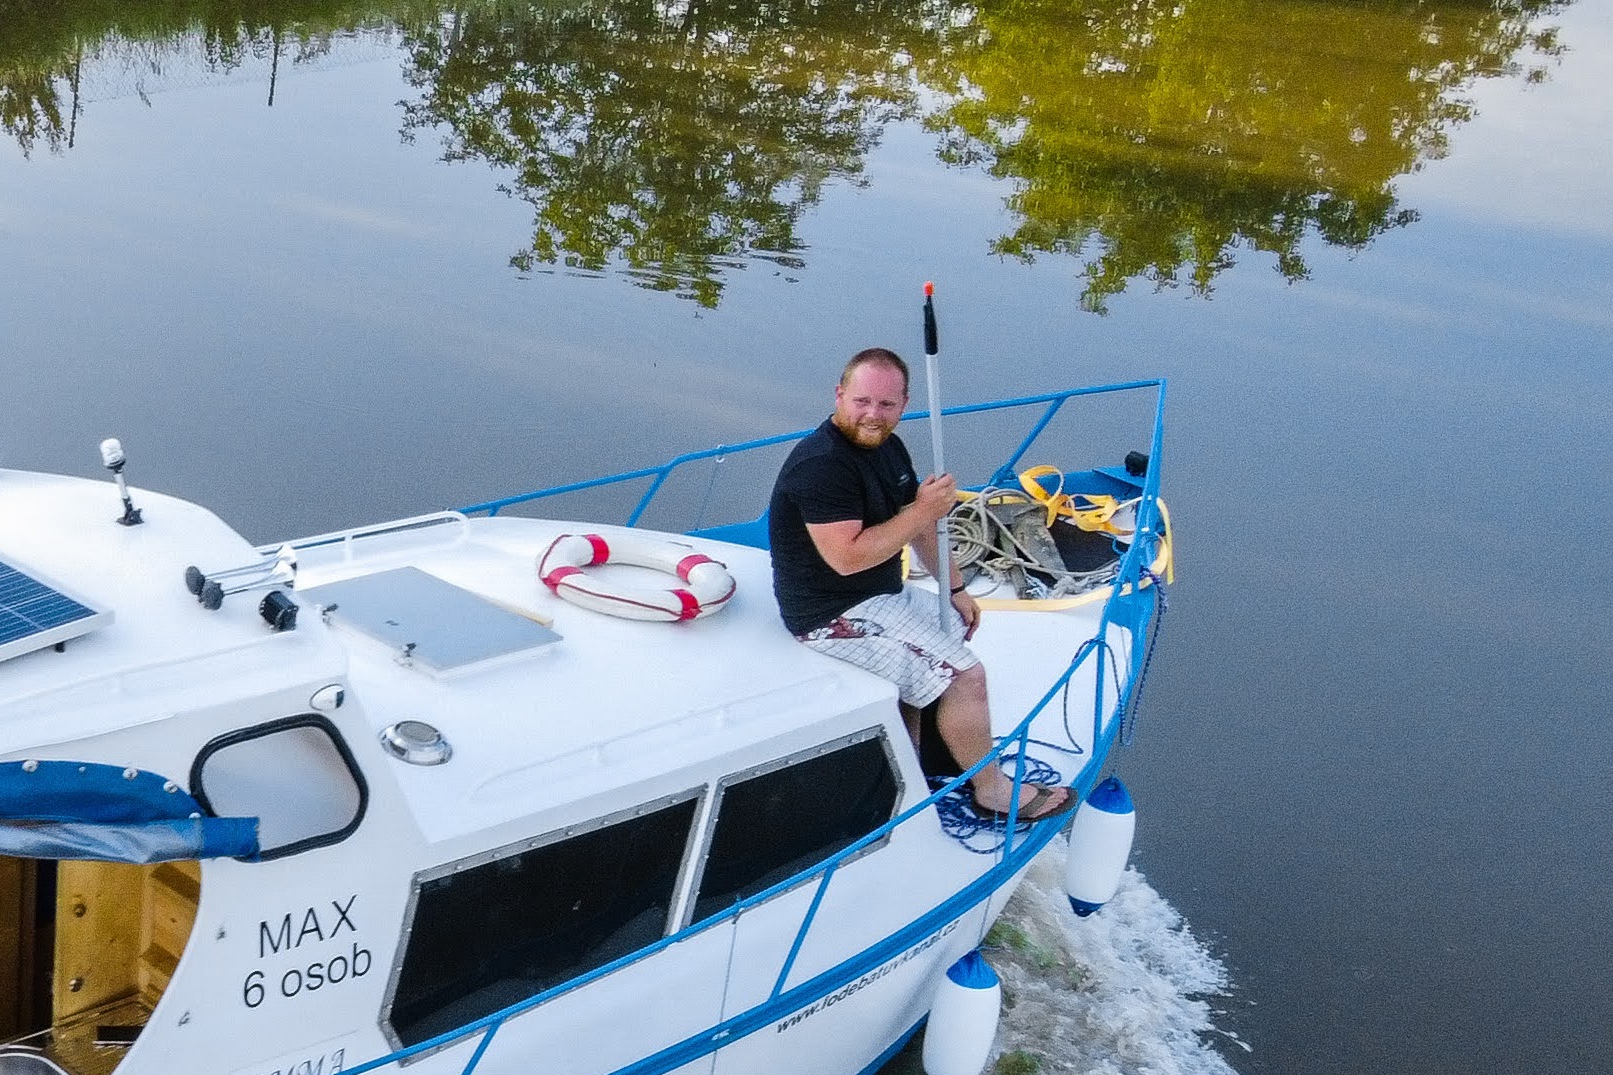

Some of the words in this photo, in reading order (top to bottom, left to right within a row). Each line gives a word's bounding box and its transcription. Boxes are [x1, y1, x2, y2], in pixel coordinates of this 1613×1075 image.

[258, 894, 358, 959] MAX
[242, 970, 266, 1008] 6
[281, 942, 372, 998] osob
